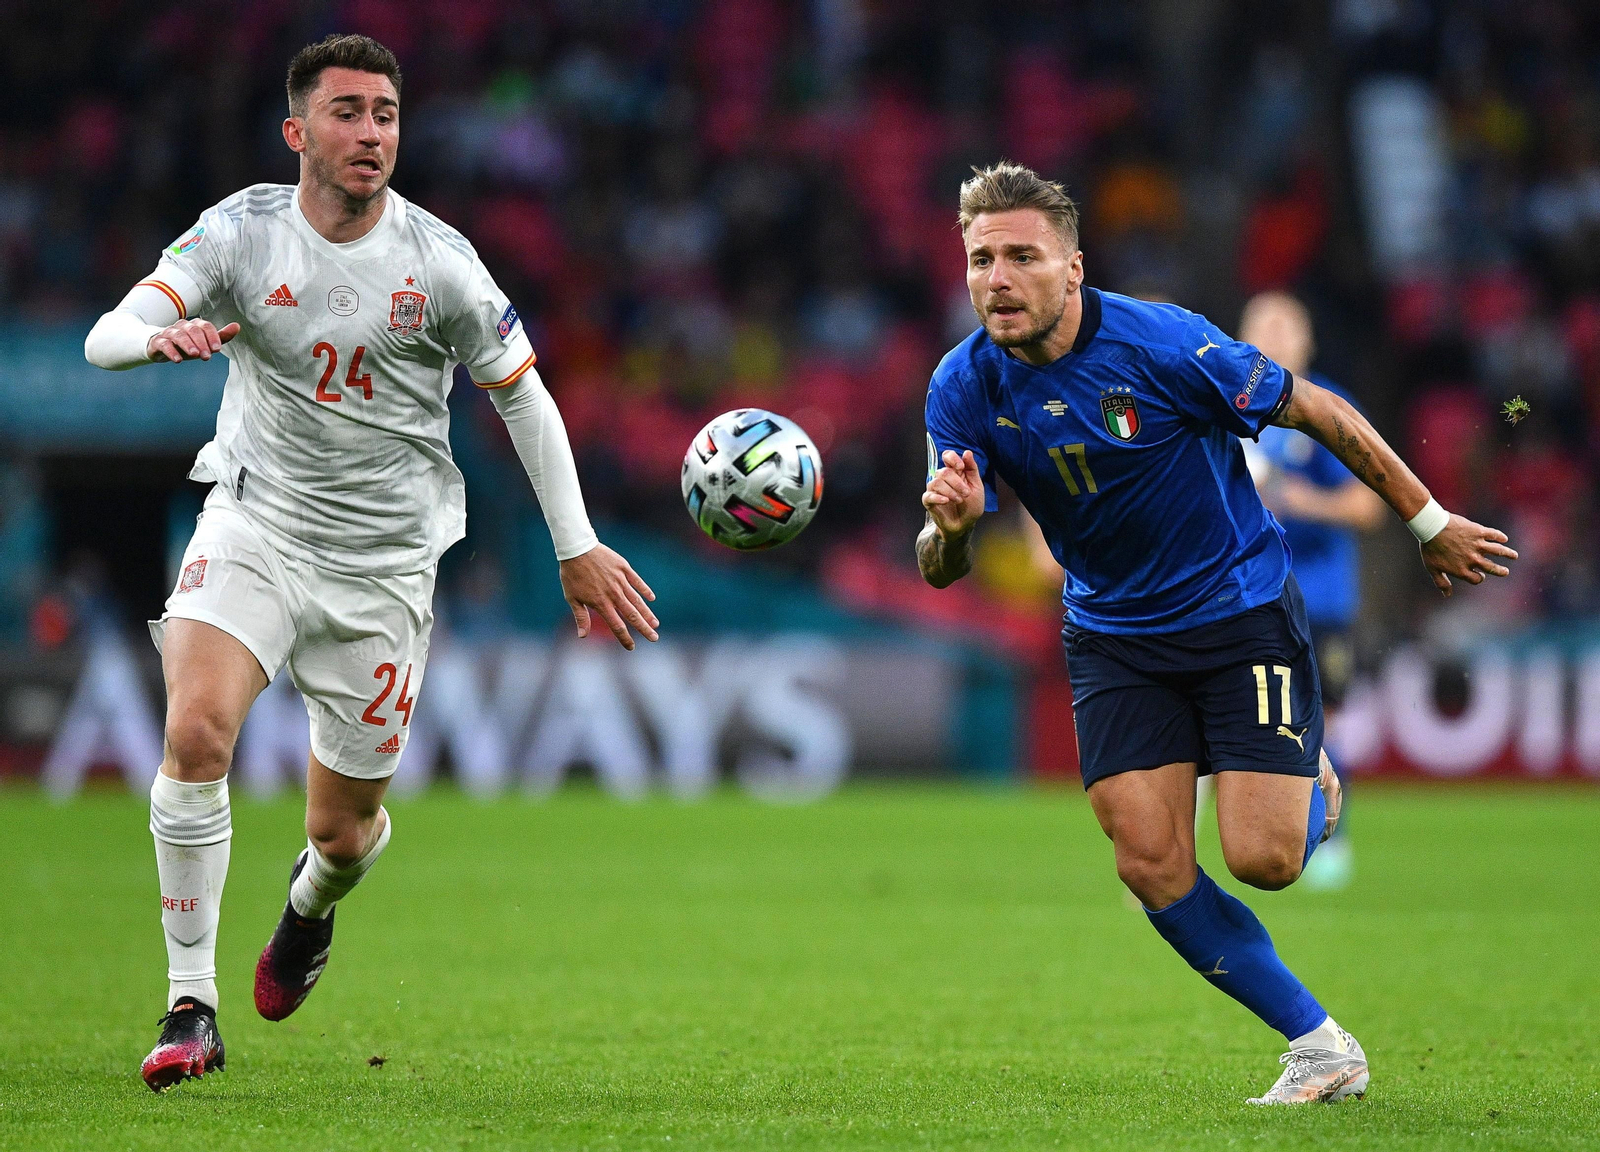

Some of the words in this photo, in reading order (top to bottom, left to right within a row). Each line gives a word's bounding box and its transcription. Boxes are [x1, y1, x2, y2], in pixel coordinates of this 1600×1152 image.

[264, 297, 299, 308] adidas
[312, 341, 373, 402] 24
[1245, 355, 1267, 395] RESPECT
[1103, 397, 1132, 409] ITALIA
[1047, 442, 1098, 497] 17
[361, 662, 413, 727] 24
[1252, 664, 1292, 725] 17
[161, 895, 199, 912] RFEF
